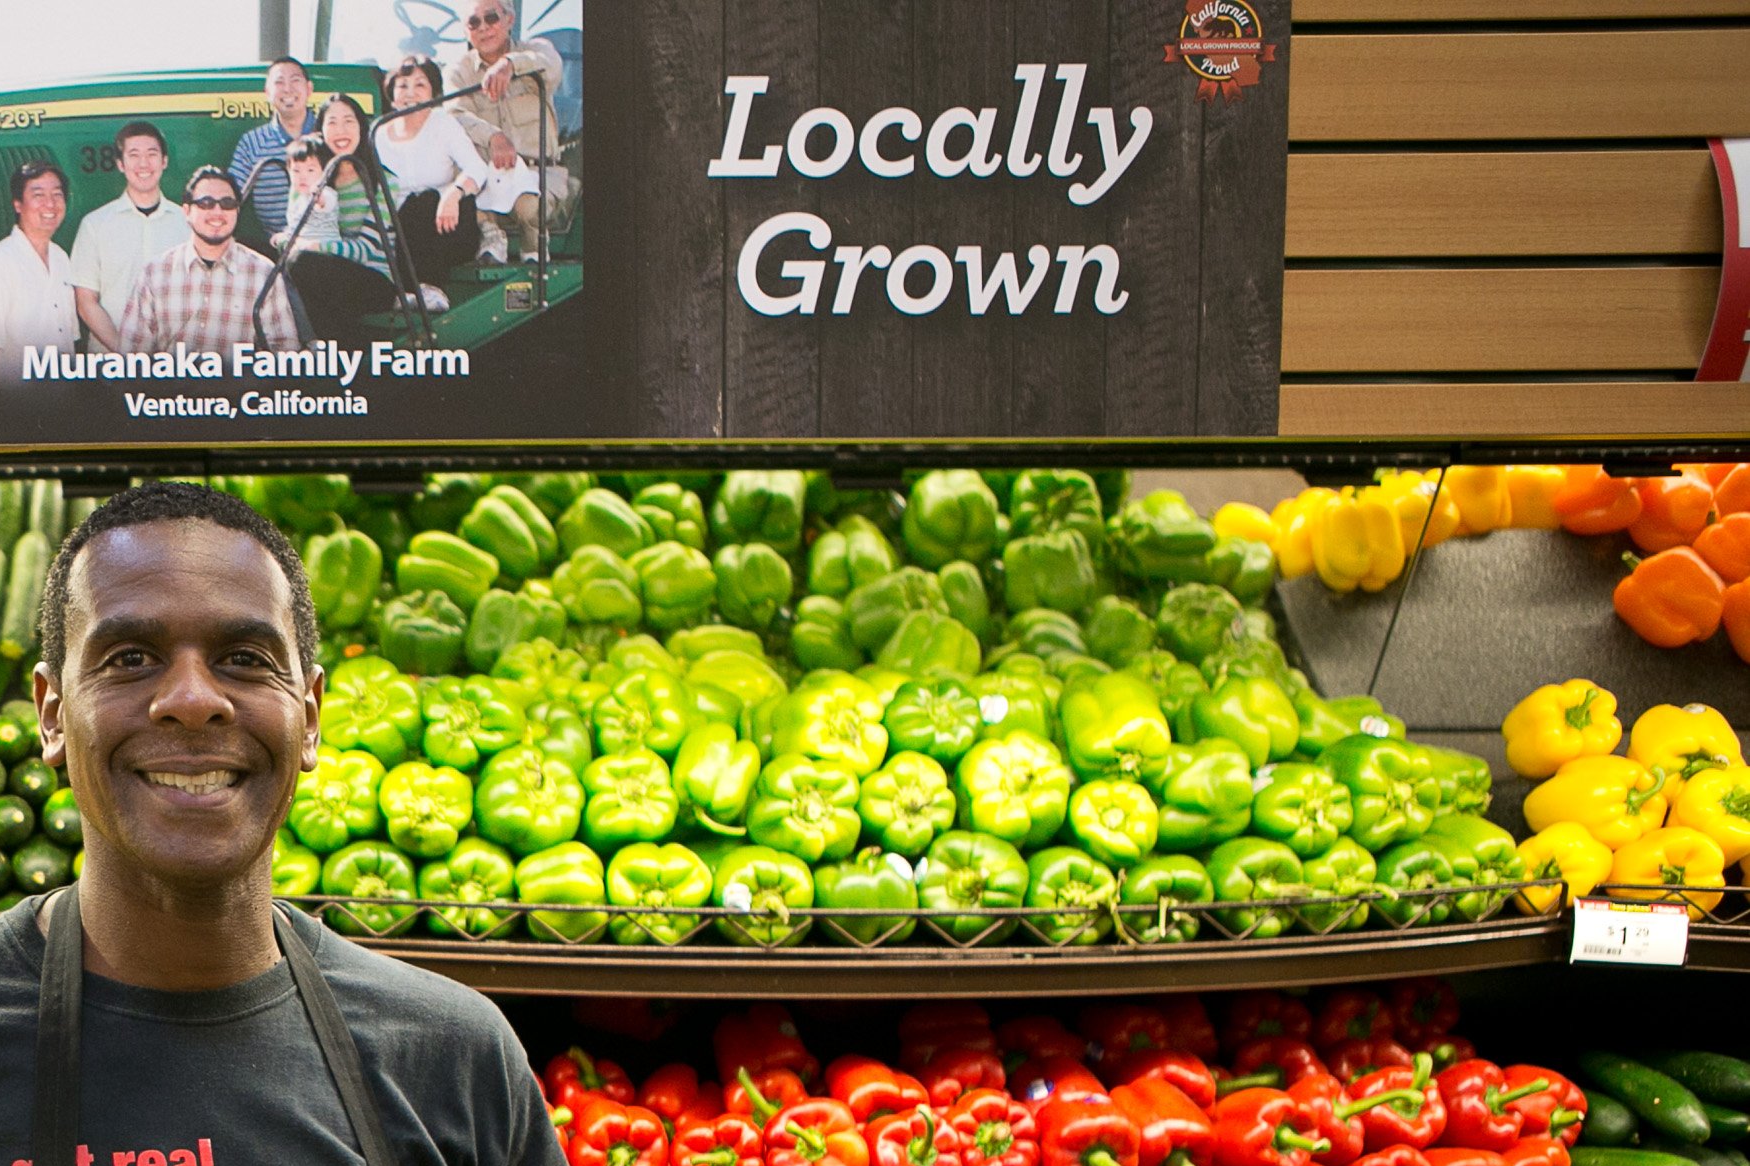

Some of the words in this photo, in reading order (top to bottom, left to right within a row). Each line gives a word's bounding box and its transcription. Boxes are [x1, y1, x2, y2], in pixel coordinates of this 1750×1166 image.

[1190, 0, 1250, 27] California
[1201, 56, 1240, 74] Proud
[706, 63, 1154, 206] Locally
[736, 211, 1130, 317] Grown
[21, 341, 224, 381] Muranaka
[232, 341, 364, 385] Family
[370, 341, 470, 376] Farm
[124, 392, 238, 419] Ventura,
[240, 389, 369, 416] California
